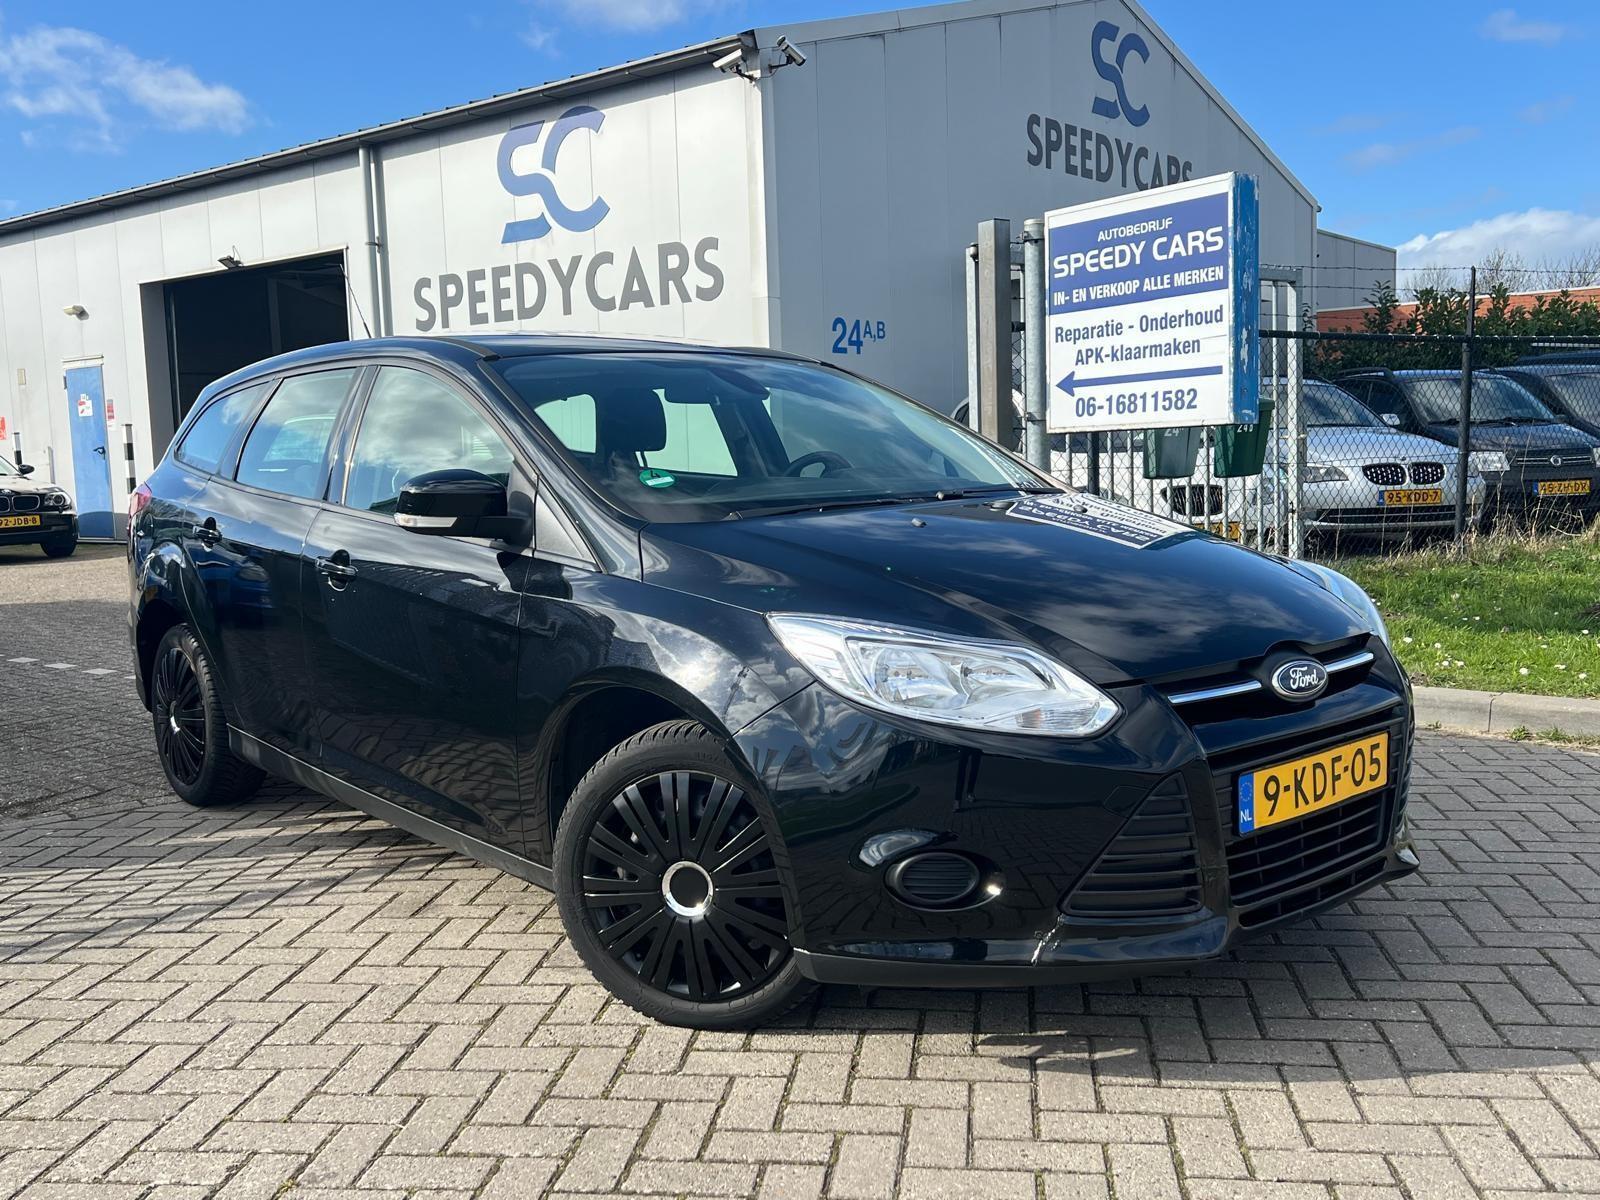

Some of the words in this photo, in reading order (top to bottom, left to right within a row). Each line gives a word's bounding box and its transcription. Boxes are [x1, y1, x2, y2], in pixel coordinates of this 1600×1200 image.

[1091, 20, 1150, 127] SC
[497, 105, 610, 244] SC
[1097, 217, 1173, 242] AUTOBEDRIJF
[1053, 241, 1146, 278] SPEEDY
[1152, 226, 1224, 261] CARS
[413, 236, 725, 332] SPEEDYCARS
[1053, 291, 1070, 306] IN-
[1072, 288, 1087, 304] EN
[1089, 280, 1140, 300] VERKOOP
[1143, 274, 1171, 292] ALLE
[1174, 266, 1224, 287] MERKEN
[1055, 320, 1123, 344] Reparatie
[1139, 305, 1224, 333] Onderhoud
[1075, 338, 1201, 366] APK-klaarmaken
[1075, 388, 1198, 418] 06-16811582
[1289, 666, 1319, 690] Ford
[1263, 742, 1381, 817] 9-KDF-05
[1240, 809, 1253, 823] NL
